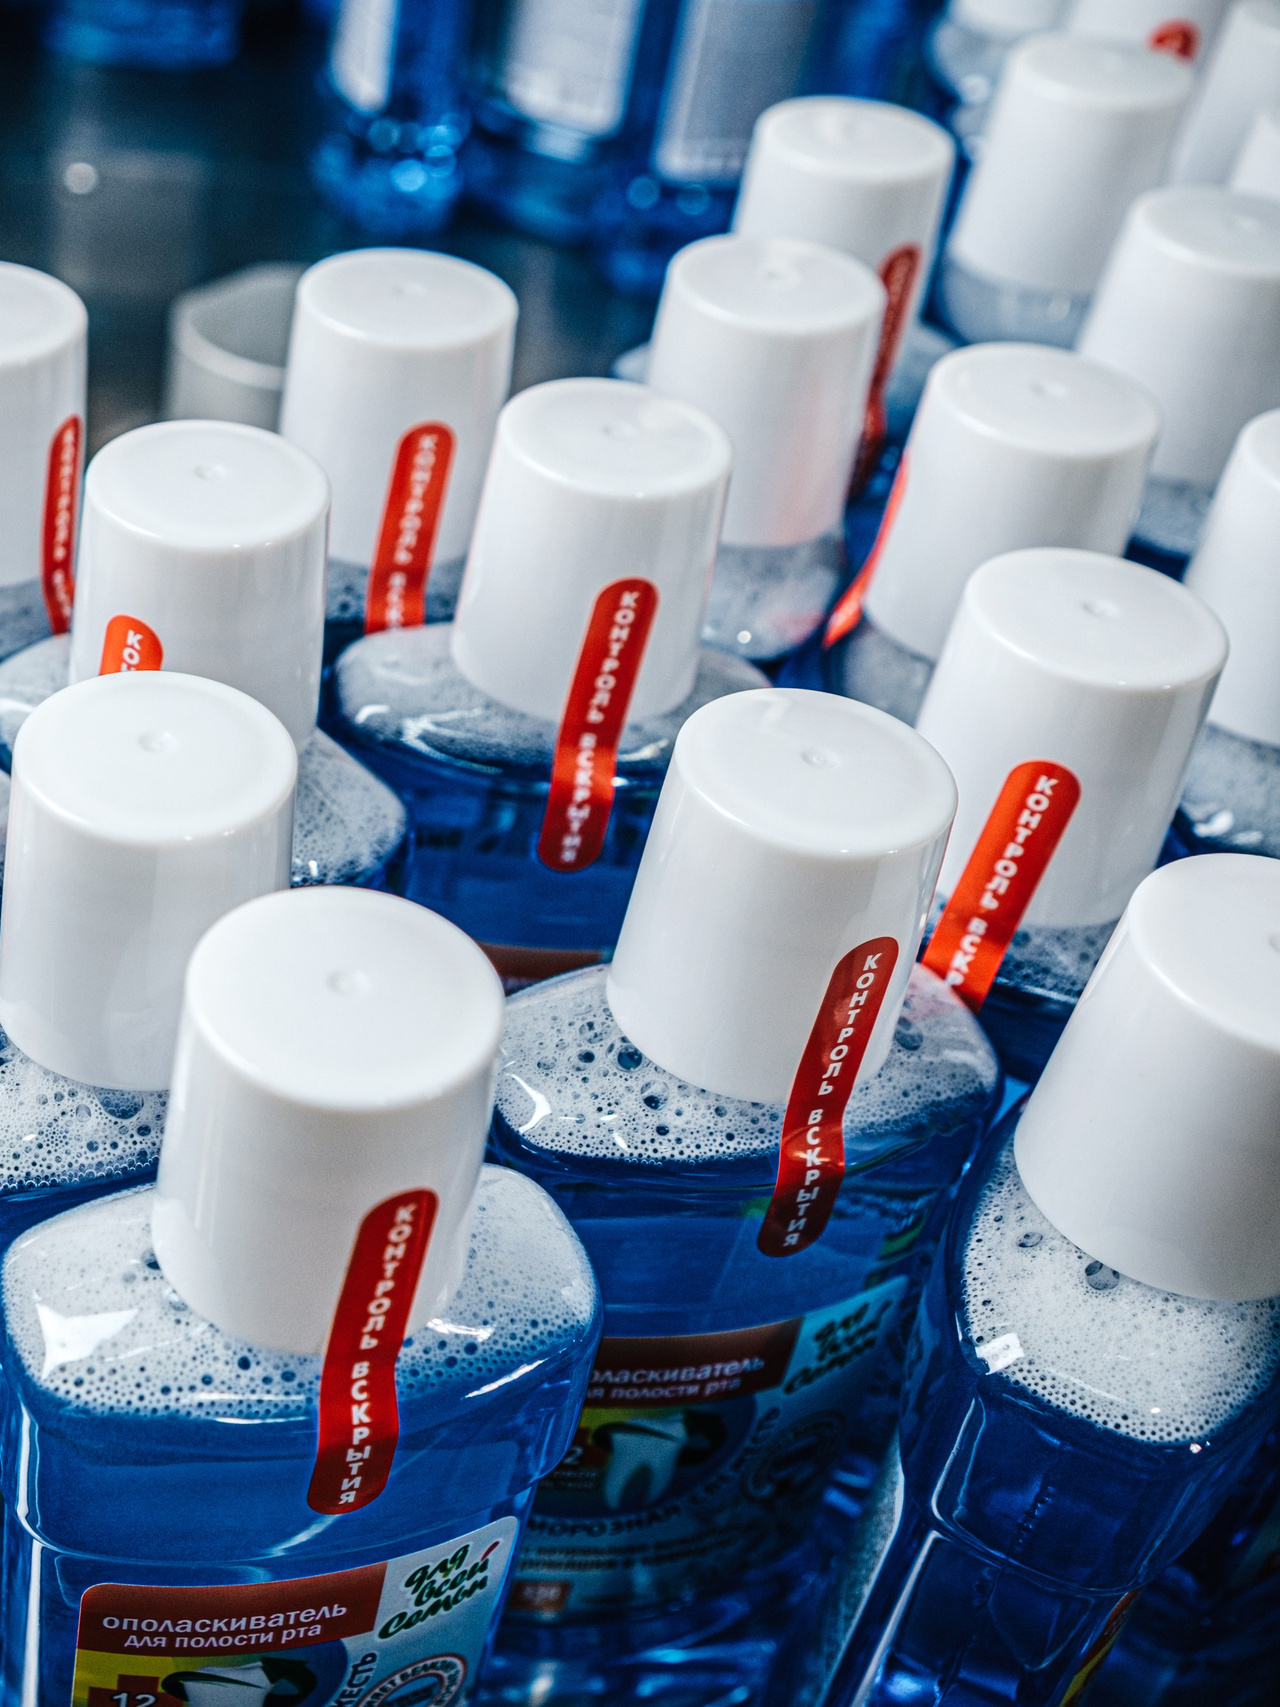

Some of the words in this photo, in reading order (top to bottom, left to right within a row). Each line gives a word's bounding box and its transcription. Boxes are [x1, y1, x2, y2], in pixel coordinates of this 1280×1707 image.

[586, 591, 640, 724] КОНТРОЛЬ
[979, 774, 1059, 911] КОНТРОЛЬ
[817, 953, 883, 1097] КОНТРОЛЬ
[783, 1108, 823, 1248] ВСКРЫТИЯ
[359, 1202, 418, 1351] КОНТРОЛЬ
[338, 1361, 372, 1505] ВСКРЫТИЯ
[102, 1603, 348, 1634] ополаскиватель
[123, 1635, 168, 1648] для
[174, 1631, 274, 1648] полости
[281, 1624, 323, 1644] рта
